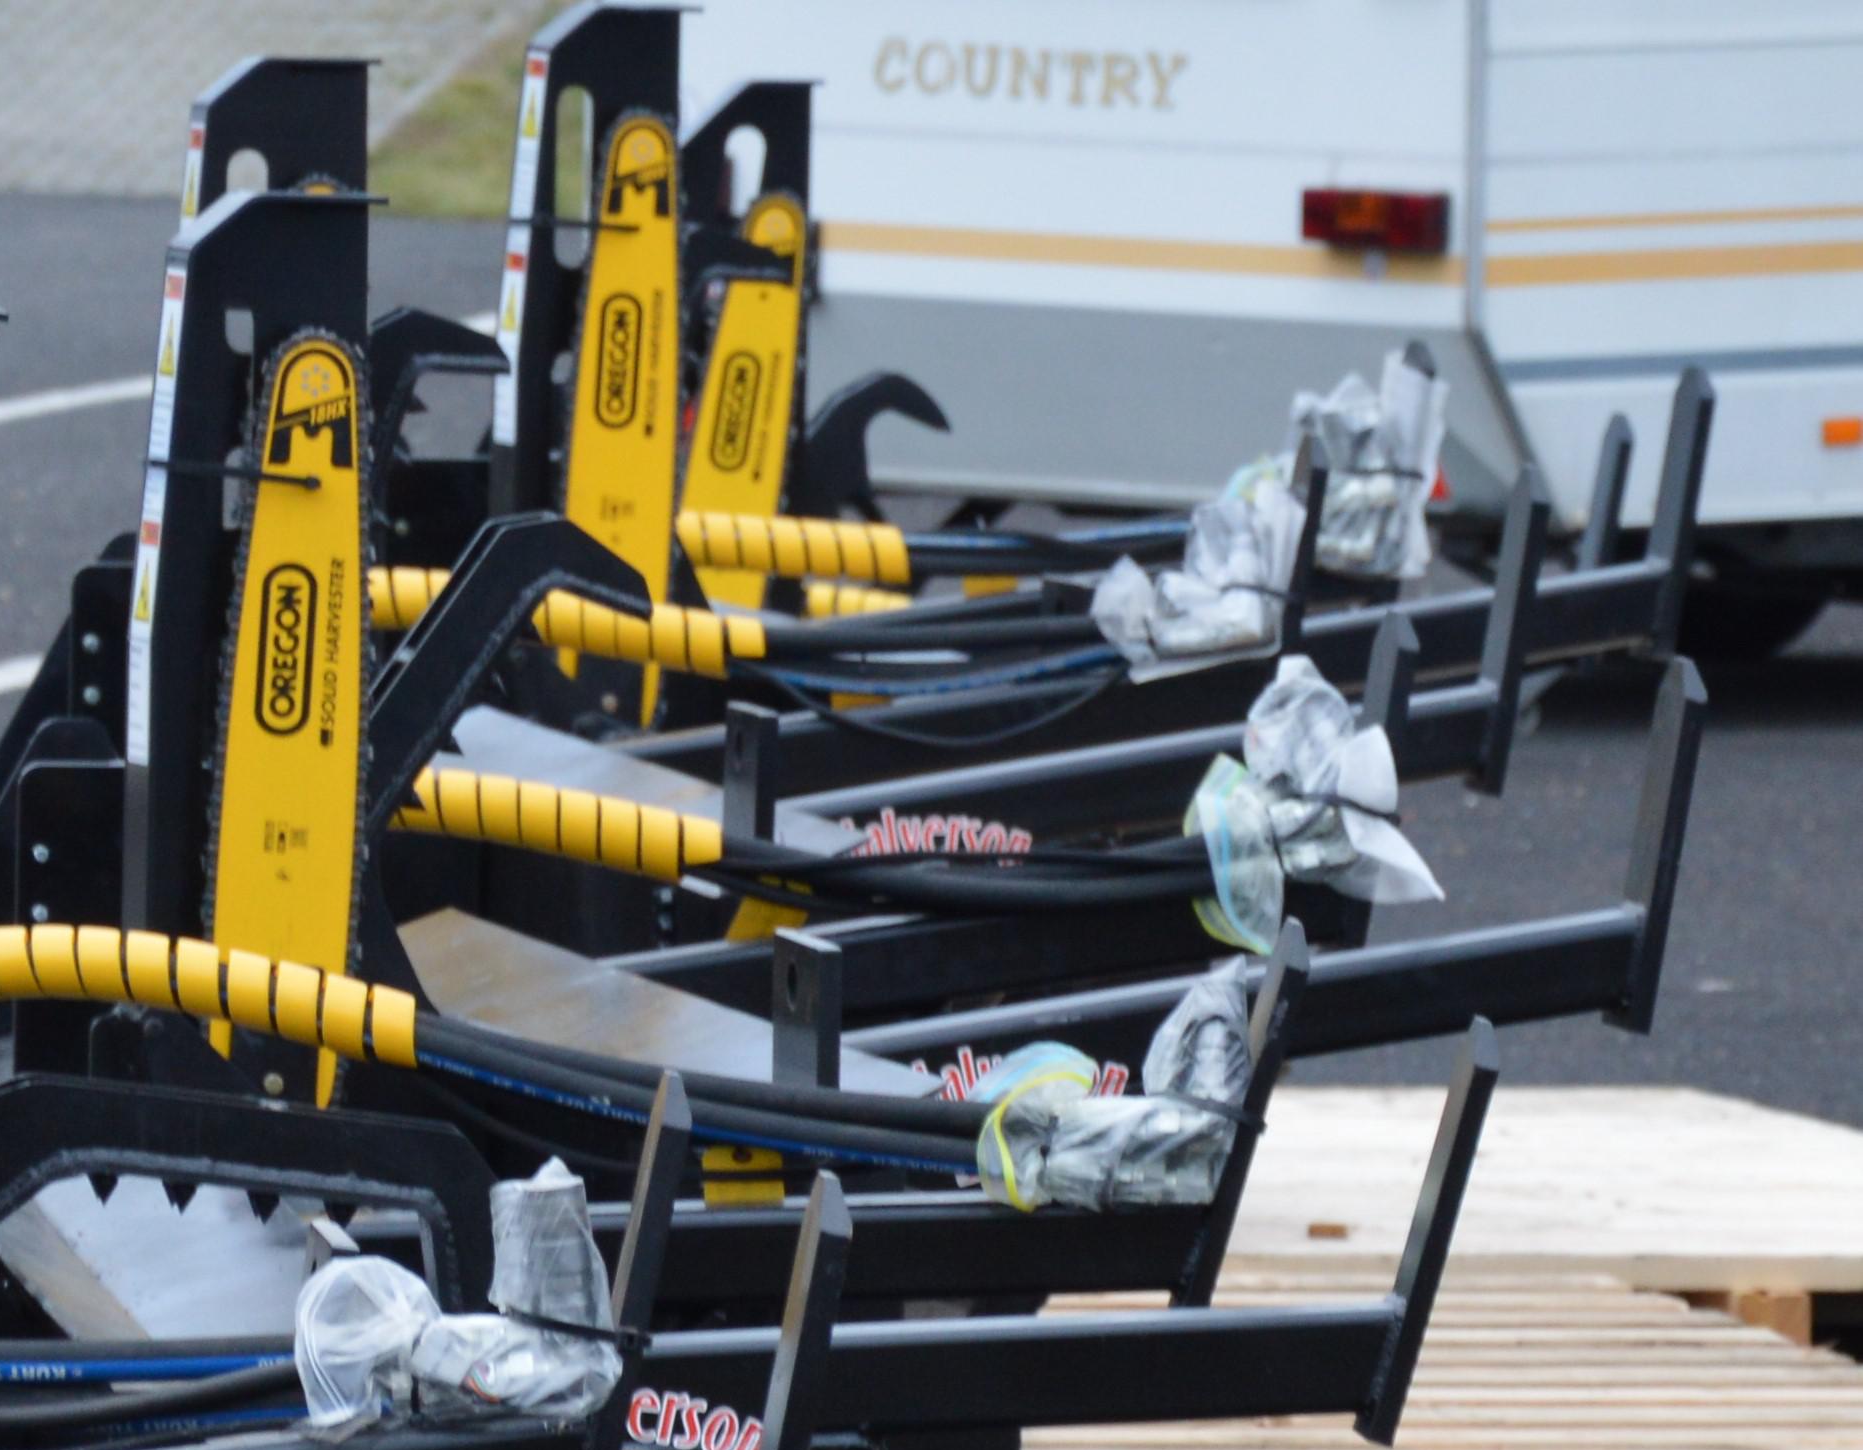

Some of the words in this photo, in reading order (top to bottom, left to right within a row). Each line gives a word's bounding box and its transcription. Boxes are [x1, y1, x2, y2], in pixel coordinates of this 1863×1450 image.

[874, 36, 1188, 109] COUNTRY
[326, 557, 344, 664] HARVESTER
[269, 584, 302, 718] OREGON
[321, 671, 338, 728] SOLID
[841, 806, 1033, 856] alverson
